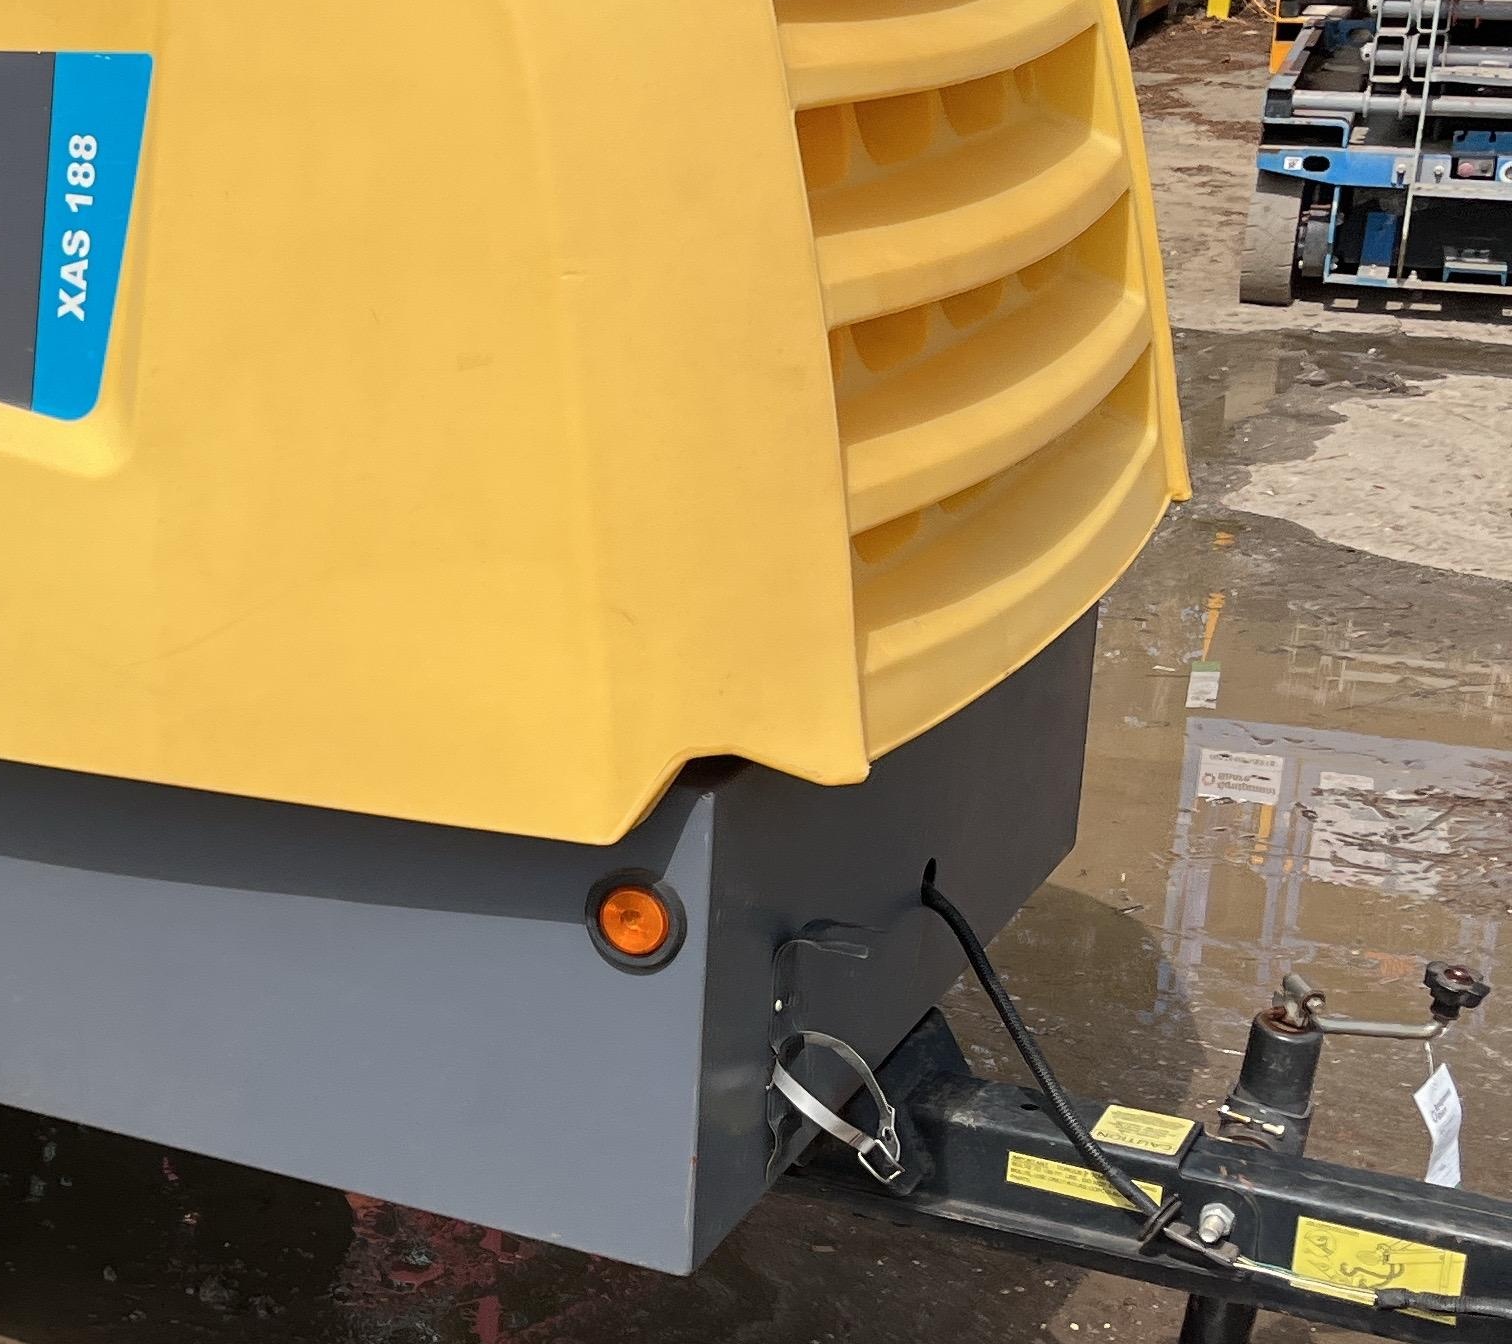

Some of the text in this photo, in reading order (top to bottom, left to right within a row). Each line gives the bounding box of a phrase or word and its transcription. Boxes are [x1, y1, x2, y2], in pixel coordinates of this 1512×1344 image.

[57, 134, 99, 322] XAS 188
[1096, 1131, 1173, 1151] CAUTION
